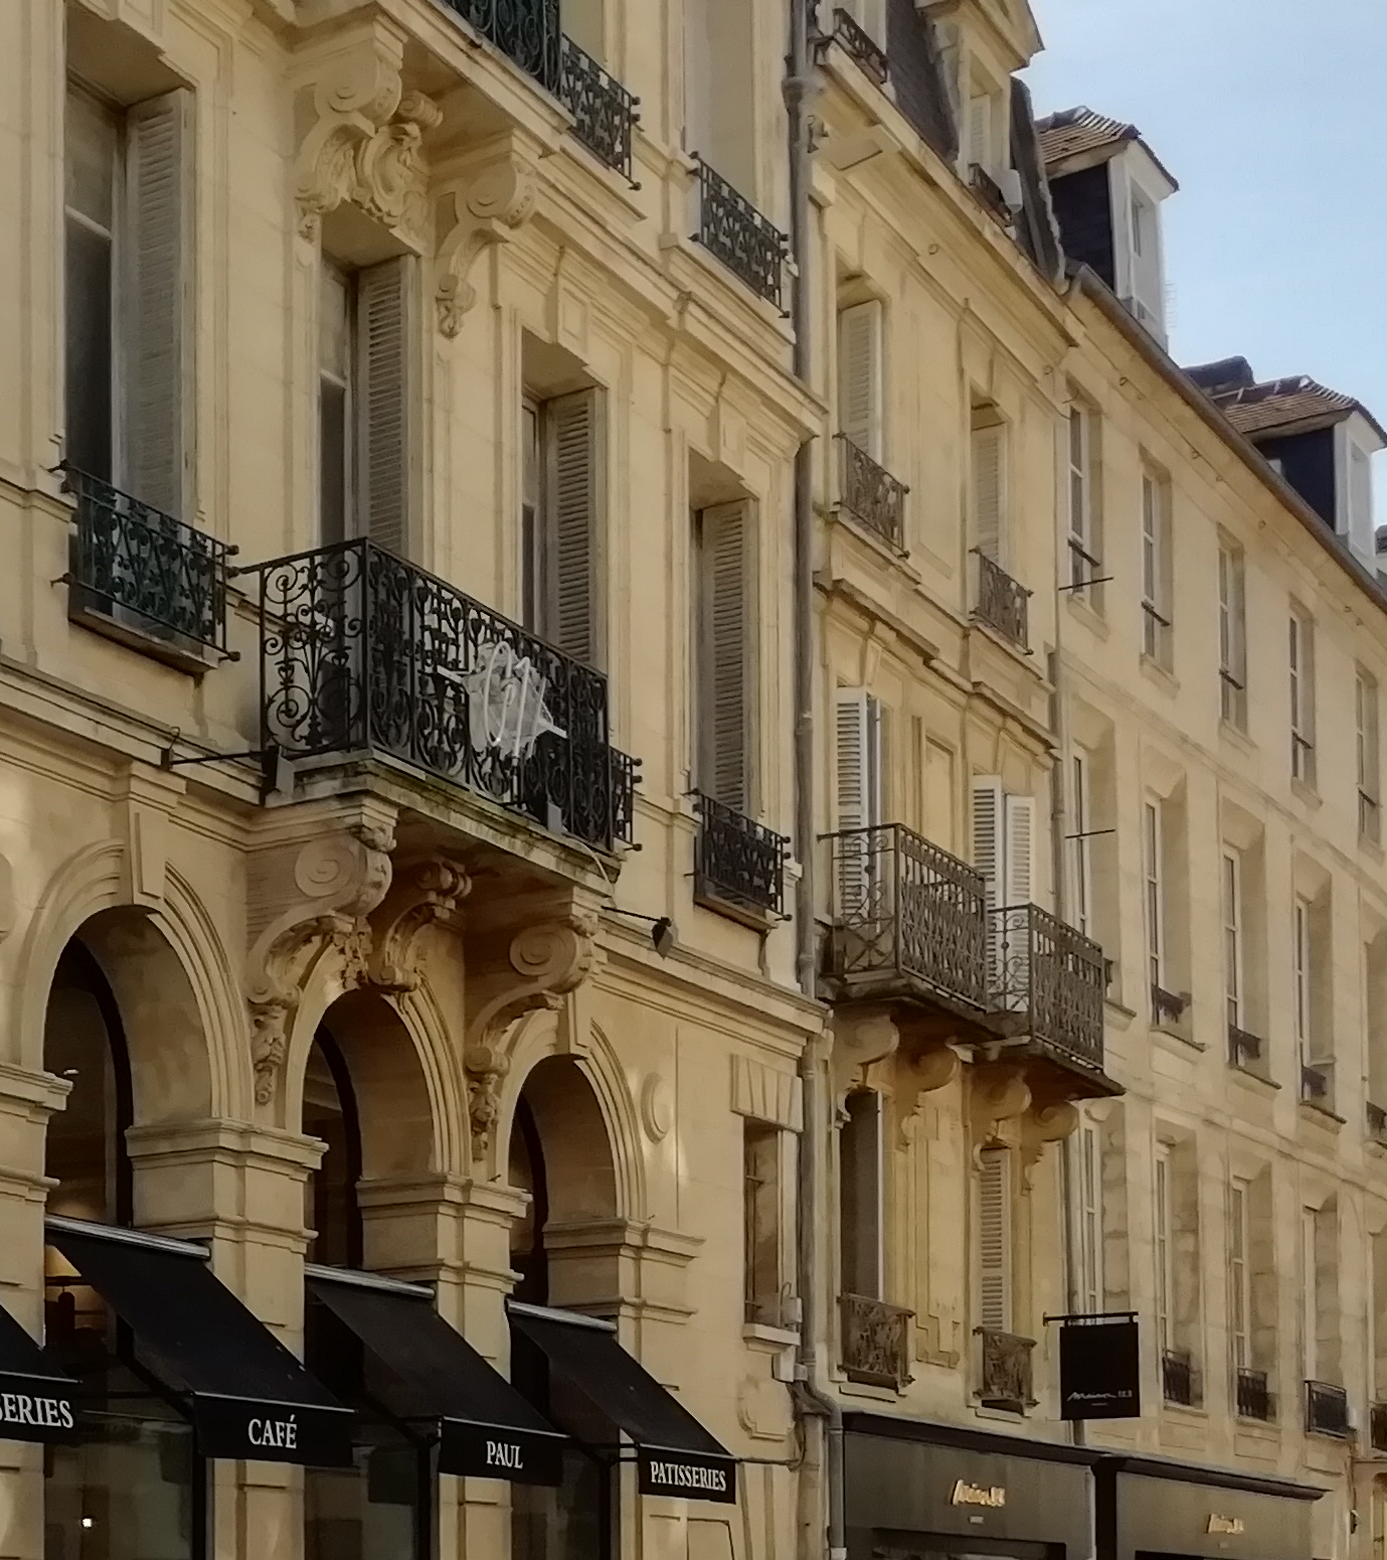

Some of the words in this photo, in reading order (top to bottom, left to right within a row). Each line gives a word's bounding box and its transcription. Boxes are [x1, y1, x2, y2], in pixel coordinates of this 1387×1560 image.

[248, 1414, 297, 1449] CAFÉ
[486, 1441, 523, 1469] PAUL
[650, 1461, 727, 1492] PATISSERIES
